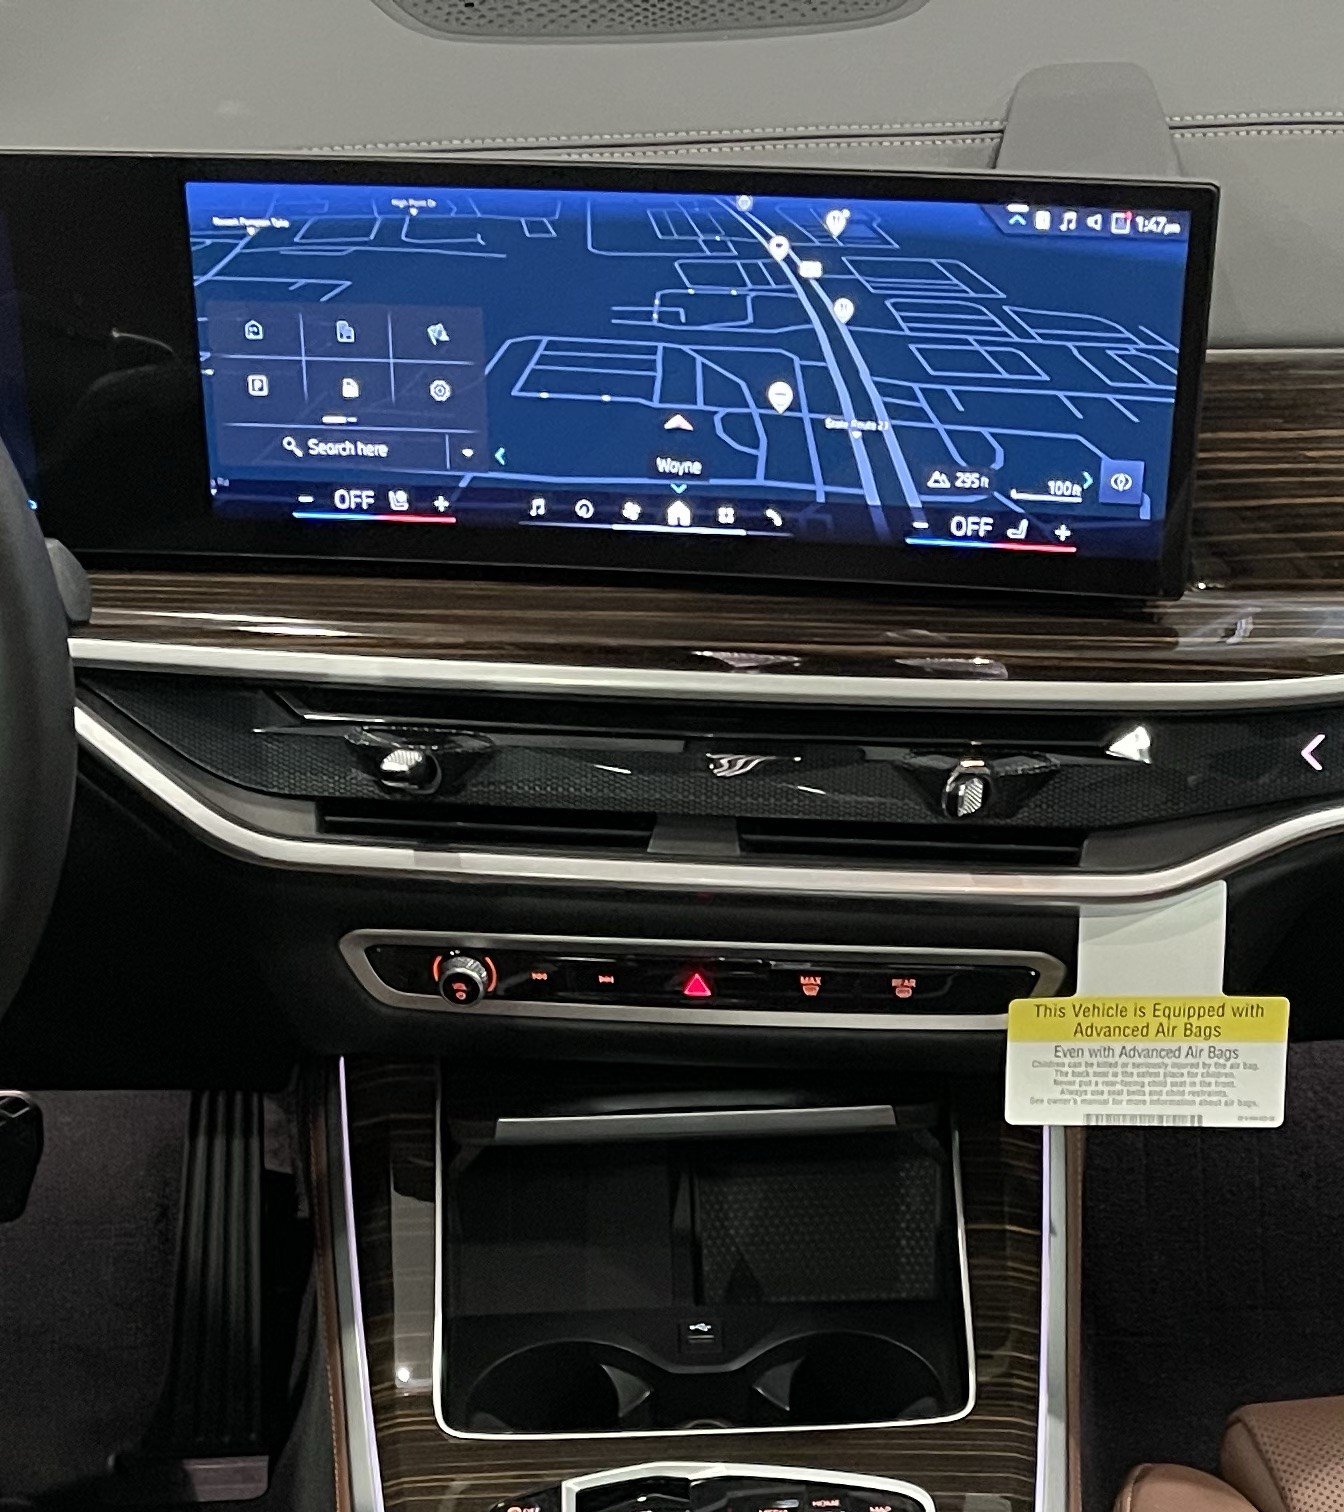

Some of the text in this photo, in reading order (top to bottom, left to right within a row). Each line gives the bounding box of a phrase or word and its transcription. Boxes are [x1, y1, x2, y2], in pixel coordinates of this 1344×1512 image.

[307, 438, 389, 457] Search here
[656, 456, 702, 476] Wayne
[334, 488, 375, 510] OFF
[950, 515, 994, 537] OFF
[1034, 1003, 1264, 1020] This Vehicle is Equipped with
[1073, 1022, 1222, 1040] Advanced Air Bags
[1054, 1045, 1240, 1061] Even with Advanced Air Bags
